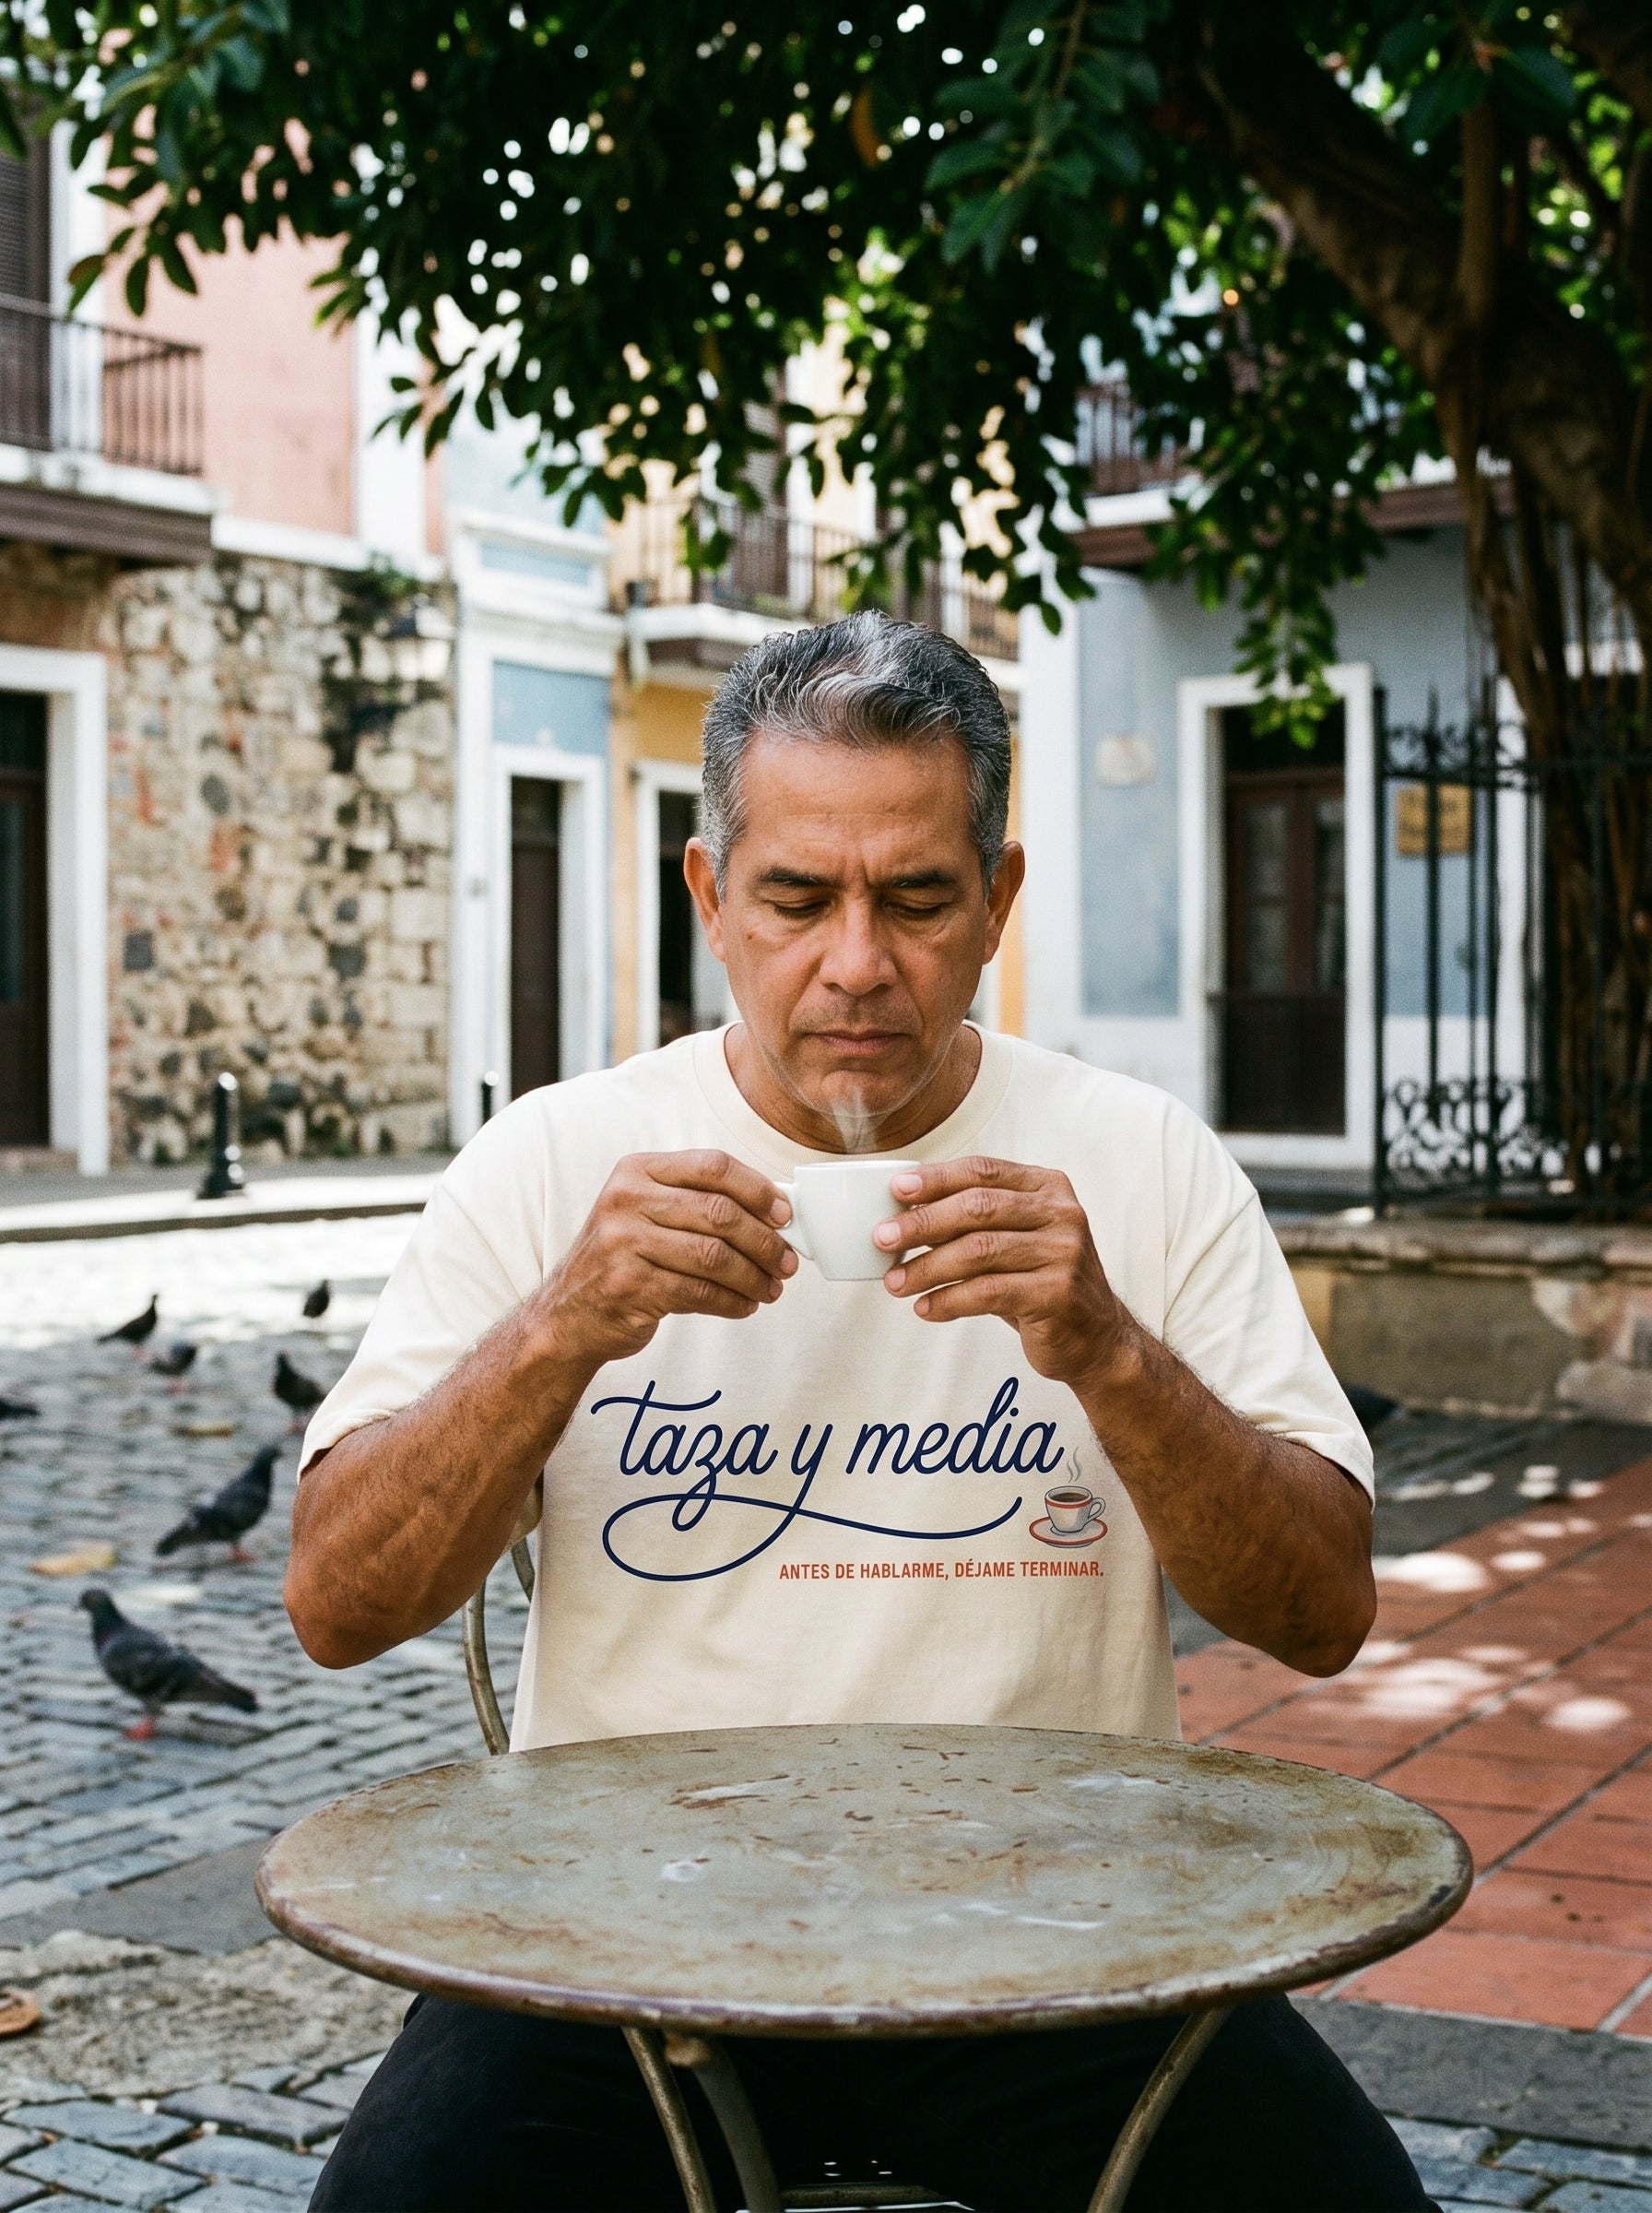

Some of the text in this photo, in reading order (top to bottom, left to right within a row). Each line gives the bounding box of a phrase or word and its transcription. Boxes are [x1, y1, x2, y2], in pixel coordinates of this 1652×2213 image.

[590, 1379, 780, 1531] taza
[845, 1377, 1065, 1475] media
[779, 1558, 1104, 1580] ANTES DE HABLARME, DÉJAME TERMINAR.
